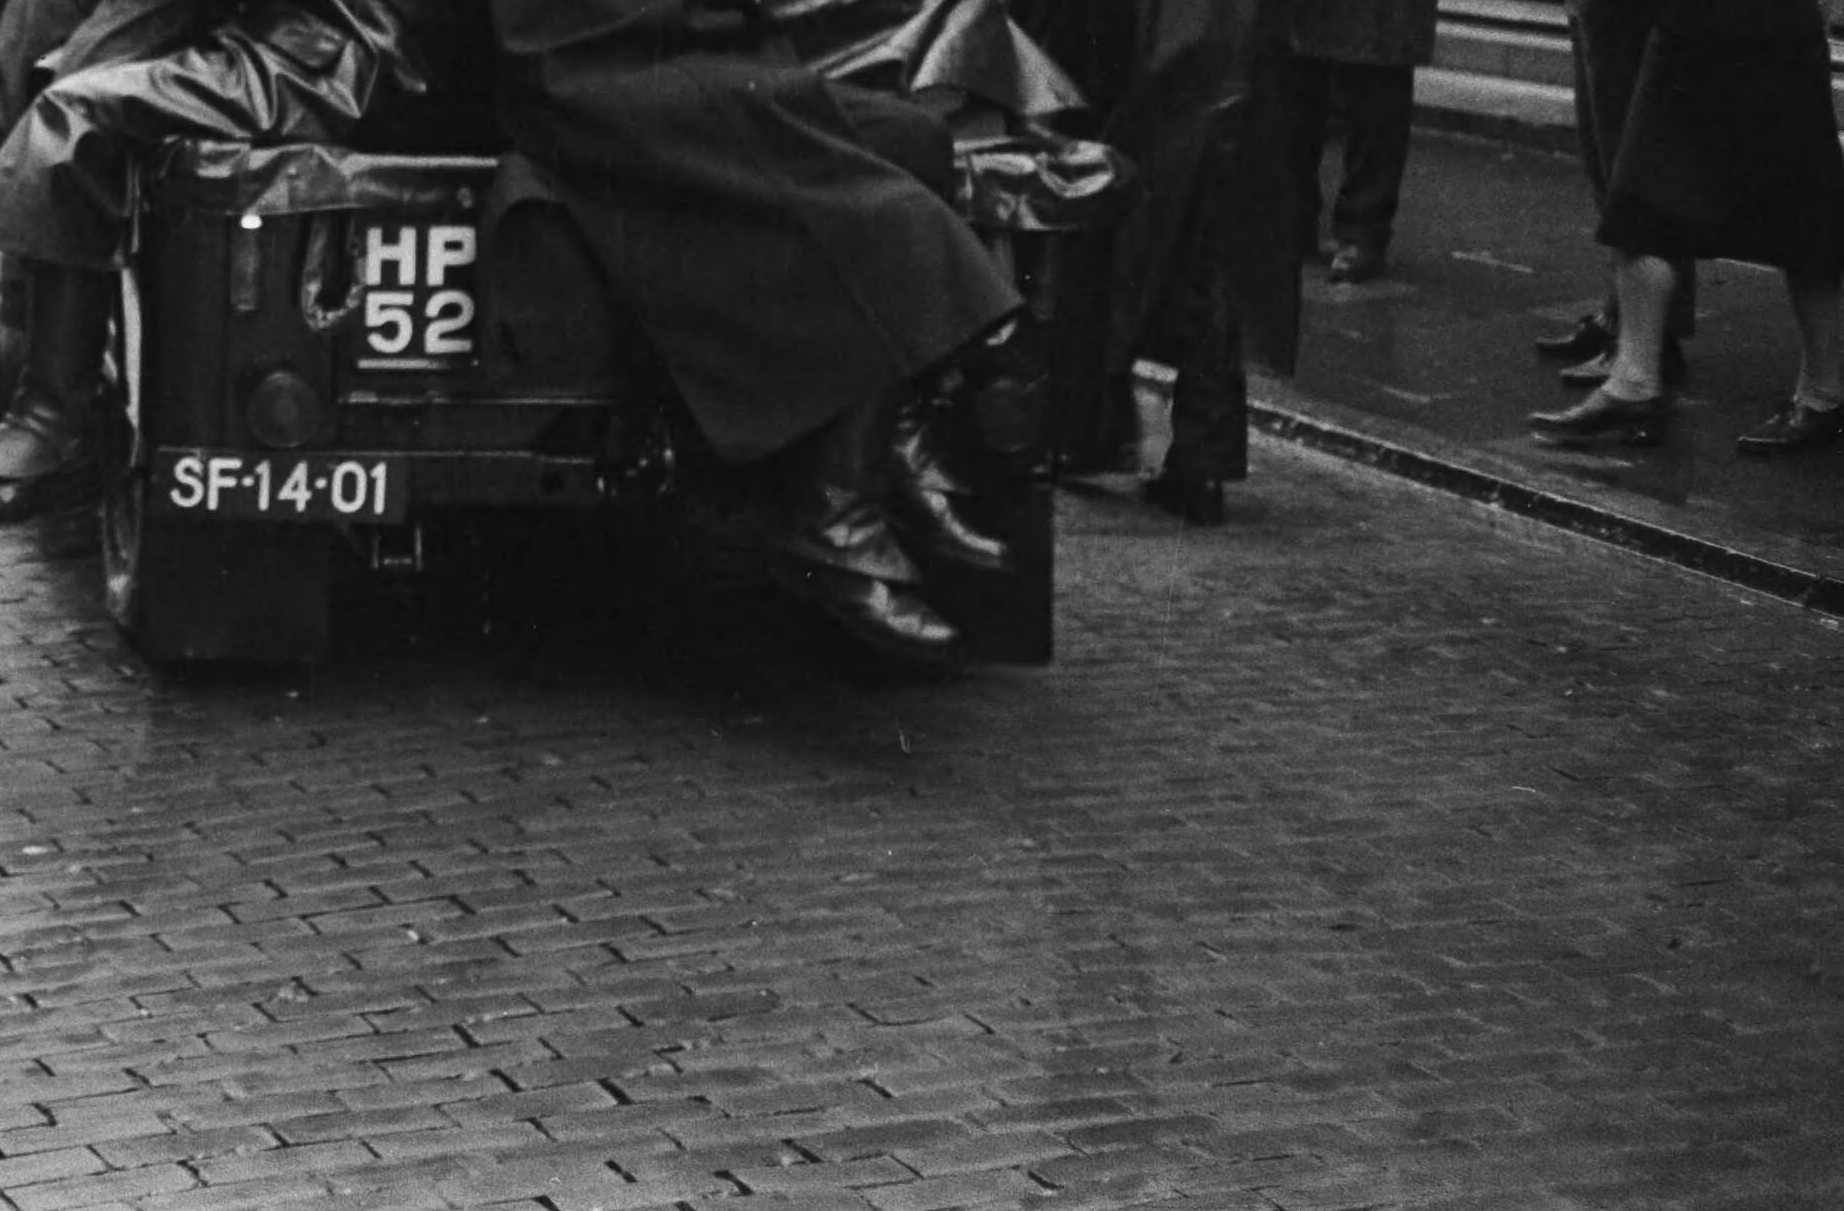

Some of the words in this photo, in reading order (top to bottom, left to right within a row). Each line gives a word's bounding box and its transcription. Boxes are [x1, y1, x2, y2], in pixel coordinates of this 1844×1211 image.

[364, 226, 477, 287] HP
[364, 290, 475, 354] 52
[169, 456, 388, 515] SF-14-01
